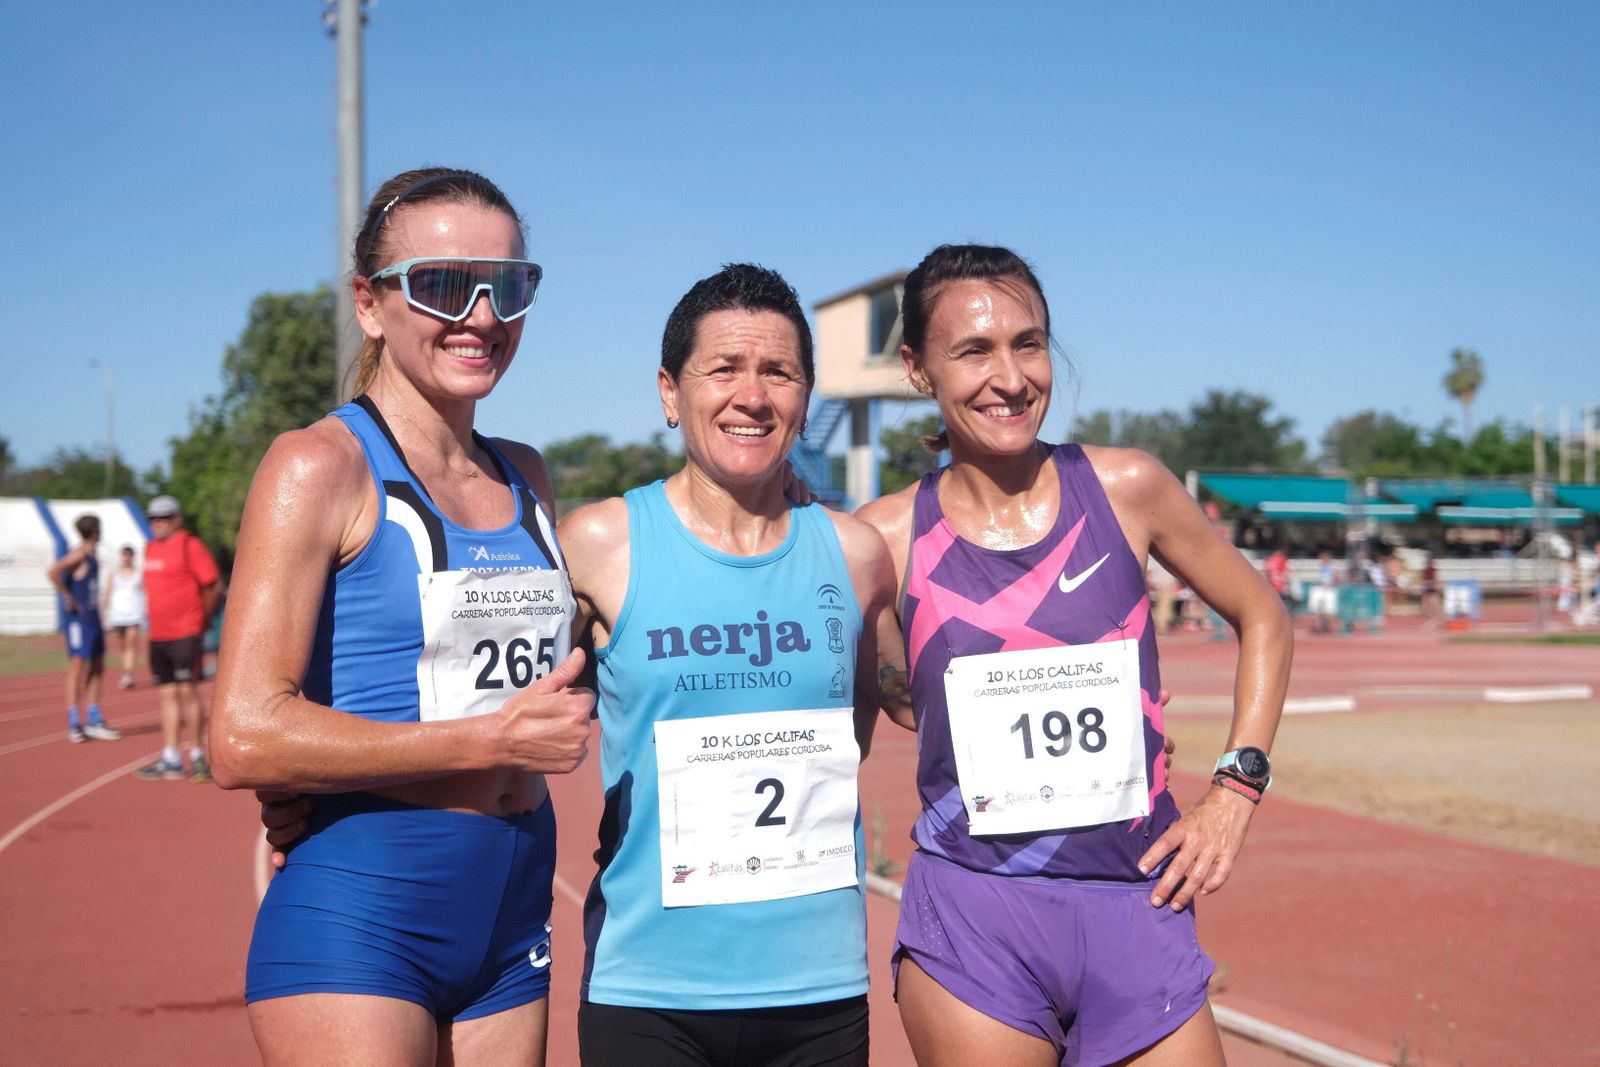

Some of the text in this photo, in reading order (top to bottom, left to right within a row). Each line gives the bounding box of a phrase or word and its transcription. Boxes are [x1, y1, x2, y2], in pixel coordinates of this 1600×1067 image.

[465, 589, 554, 604] 10 K LOS CALIFAS
[452, 606, 566, 619] CARRERAS POPULARES CORDOBA
[646, 609, 812, 667] nerja
[472, 637, 555, 690] 265
[987, 662, 1103, 683] 10 K LOS CALIFAS
[674, 670, 792, 692] ATLETISMO
[974, 676, 1119, 698] CARRERAS POPULARES CORDOBA
[701, 729, 815, 749] 10 K LOS CALIFAS
[1010, 707, 1107, 759] 198
[686, 744, 832, 763] CARRERAS POPULARES CORDOBA
[754, 777, 786, 827] 2
[826, 844, 853, 857] IMDECO
